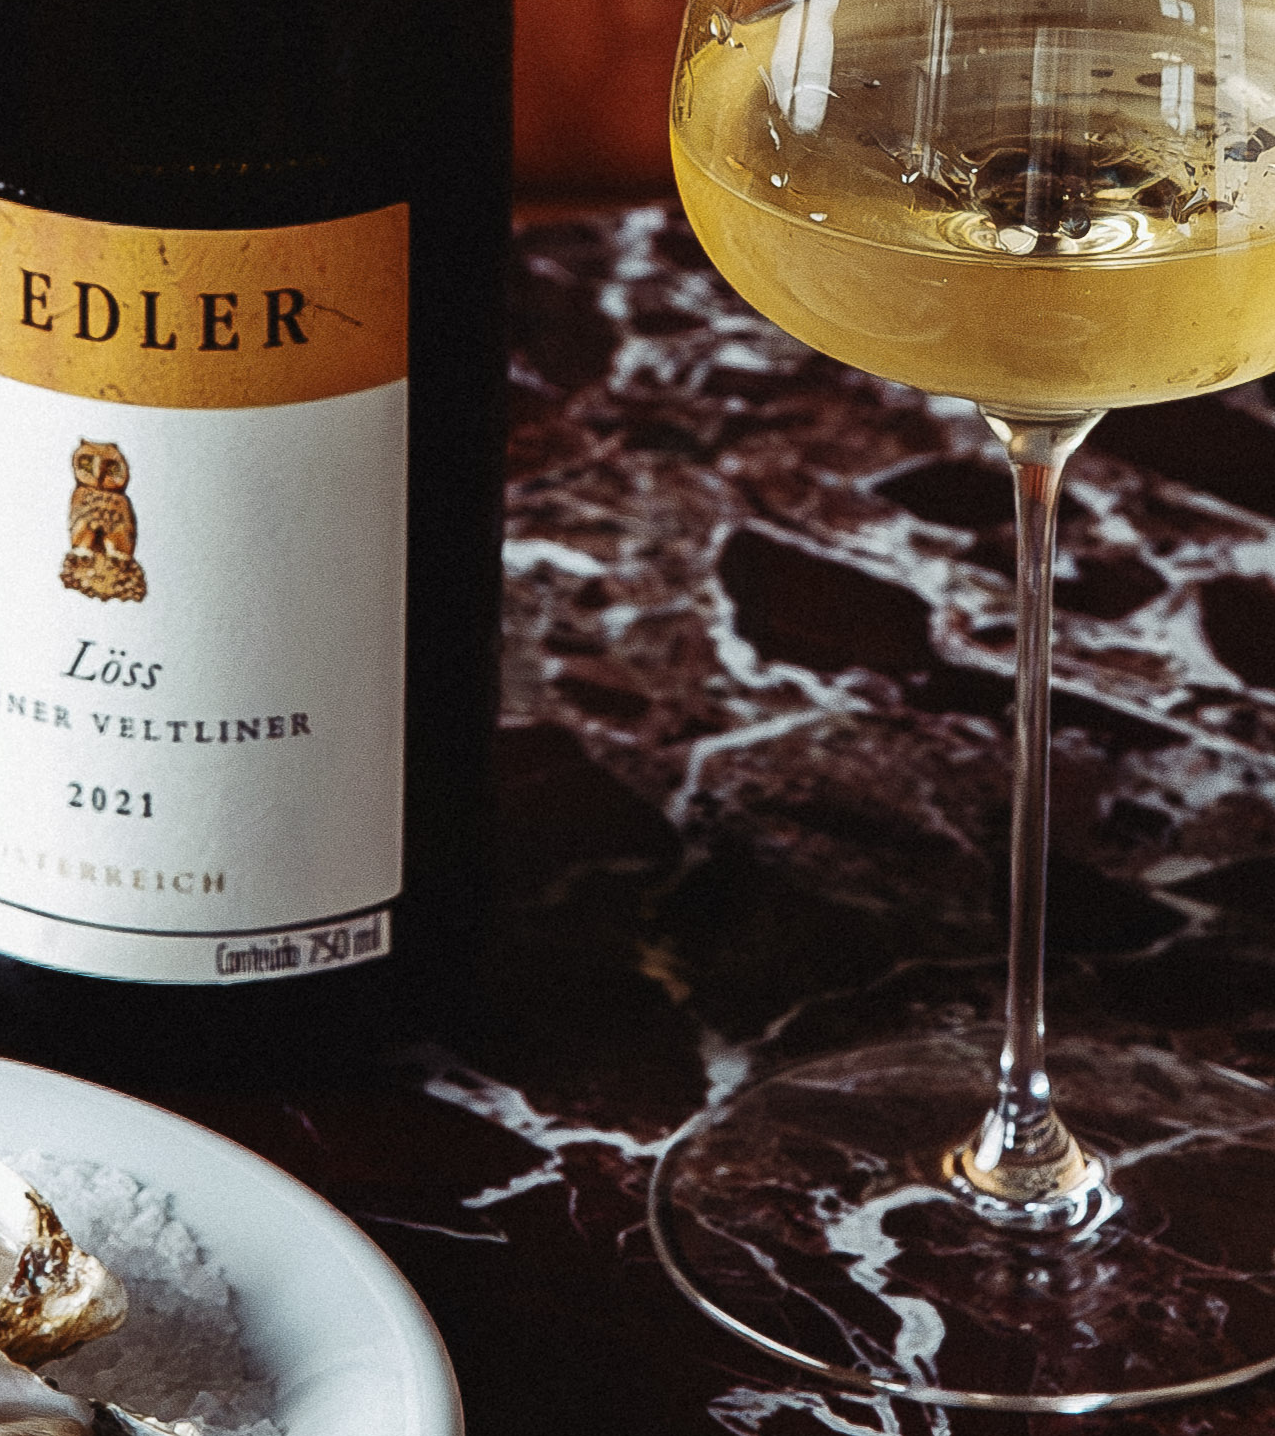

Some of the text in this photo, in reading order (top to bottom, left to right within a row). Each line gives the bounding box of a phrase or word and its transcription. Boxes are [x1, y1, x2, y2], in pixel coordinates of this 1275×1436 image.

[60, 638, 163, 690] Löss
[91, 712, 314, 743] VELTLINER
[67, 781, 154, 818] 2021
[309, 927, 351, 964] 750
